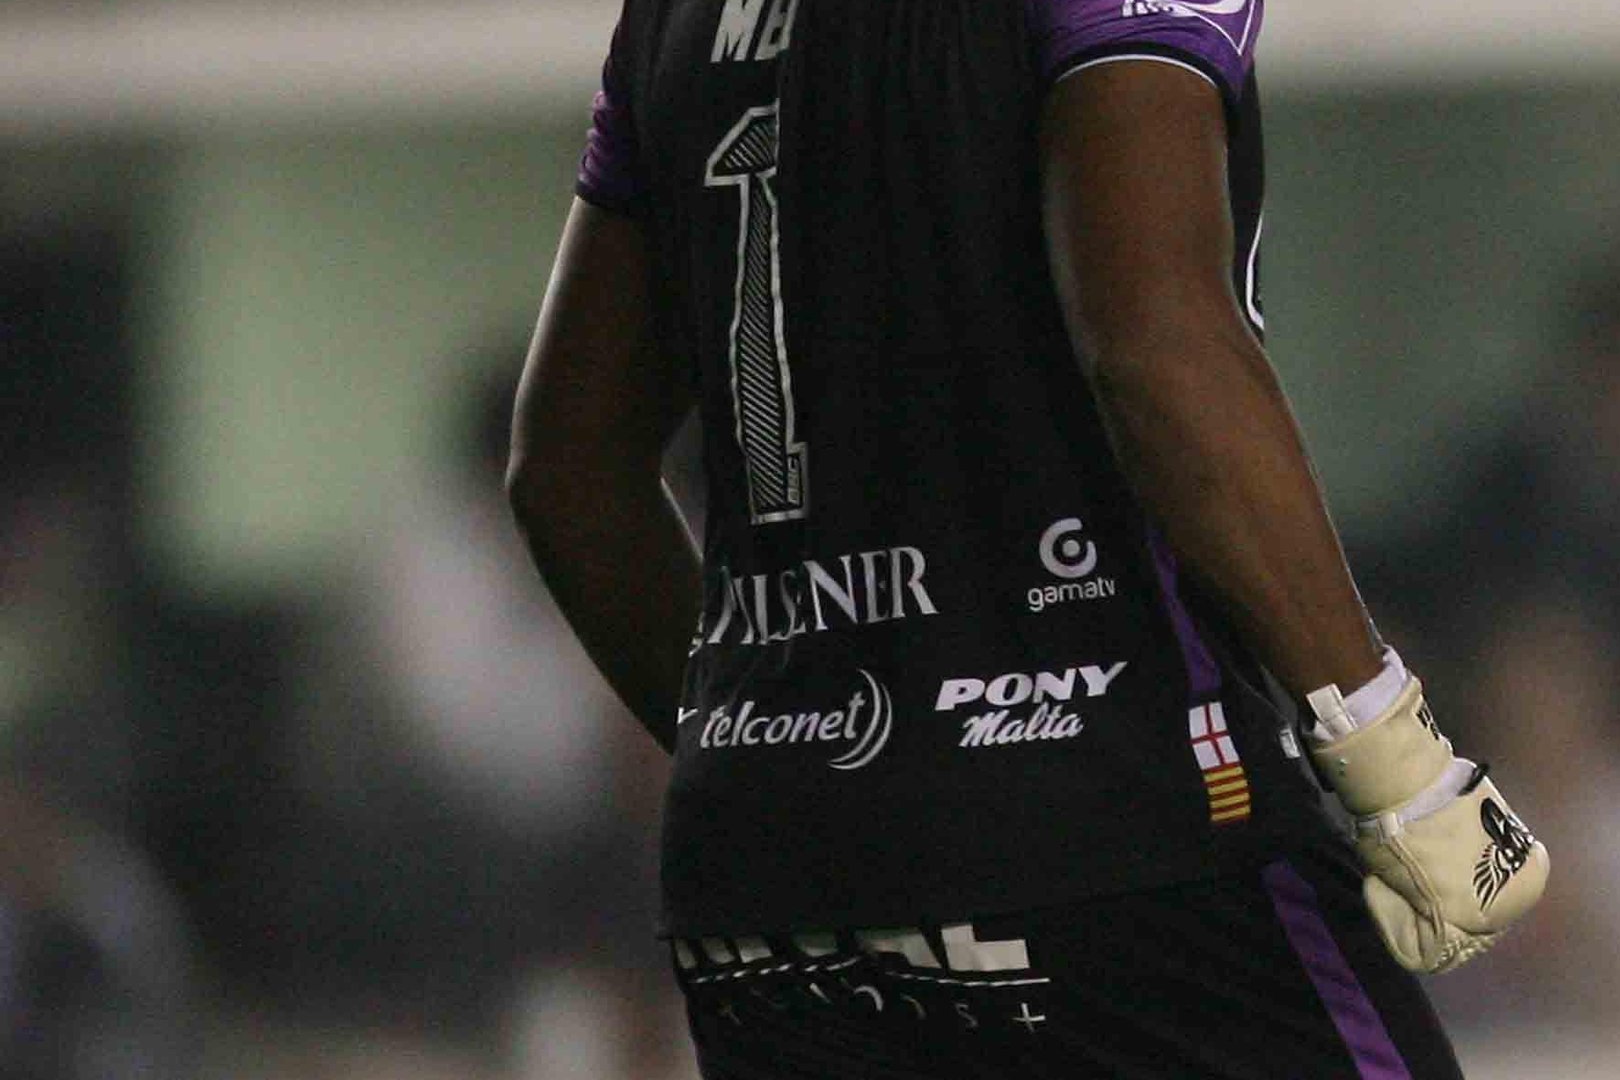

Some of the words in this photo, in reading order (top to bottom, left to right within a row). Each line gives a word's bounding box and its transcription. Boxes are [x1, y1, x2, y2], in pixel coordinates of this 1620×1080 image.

[703, 97, 809, 525] 1
[1026, 576, 1116, 612] gamatv
[934, 661, 1128, 711] PONY
[699, 691, 866, 749] telconet
[957, 701, 1084, 748] Malta
